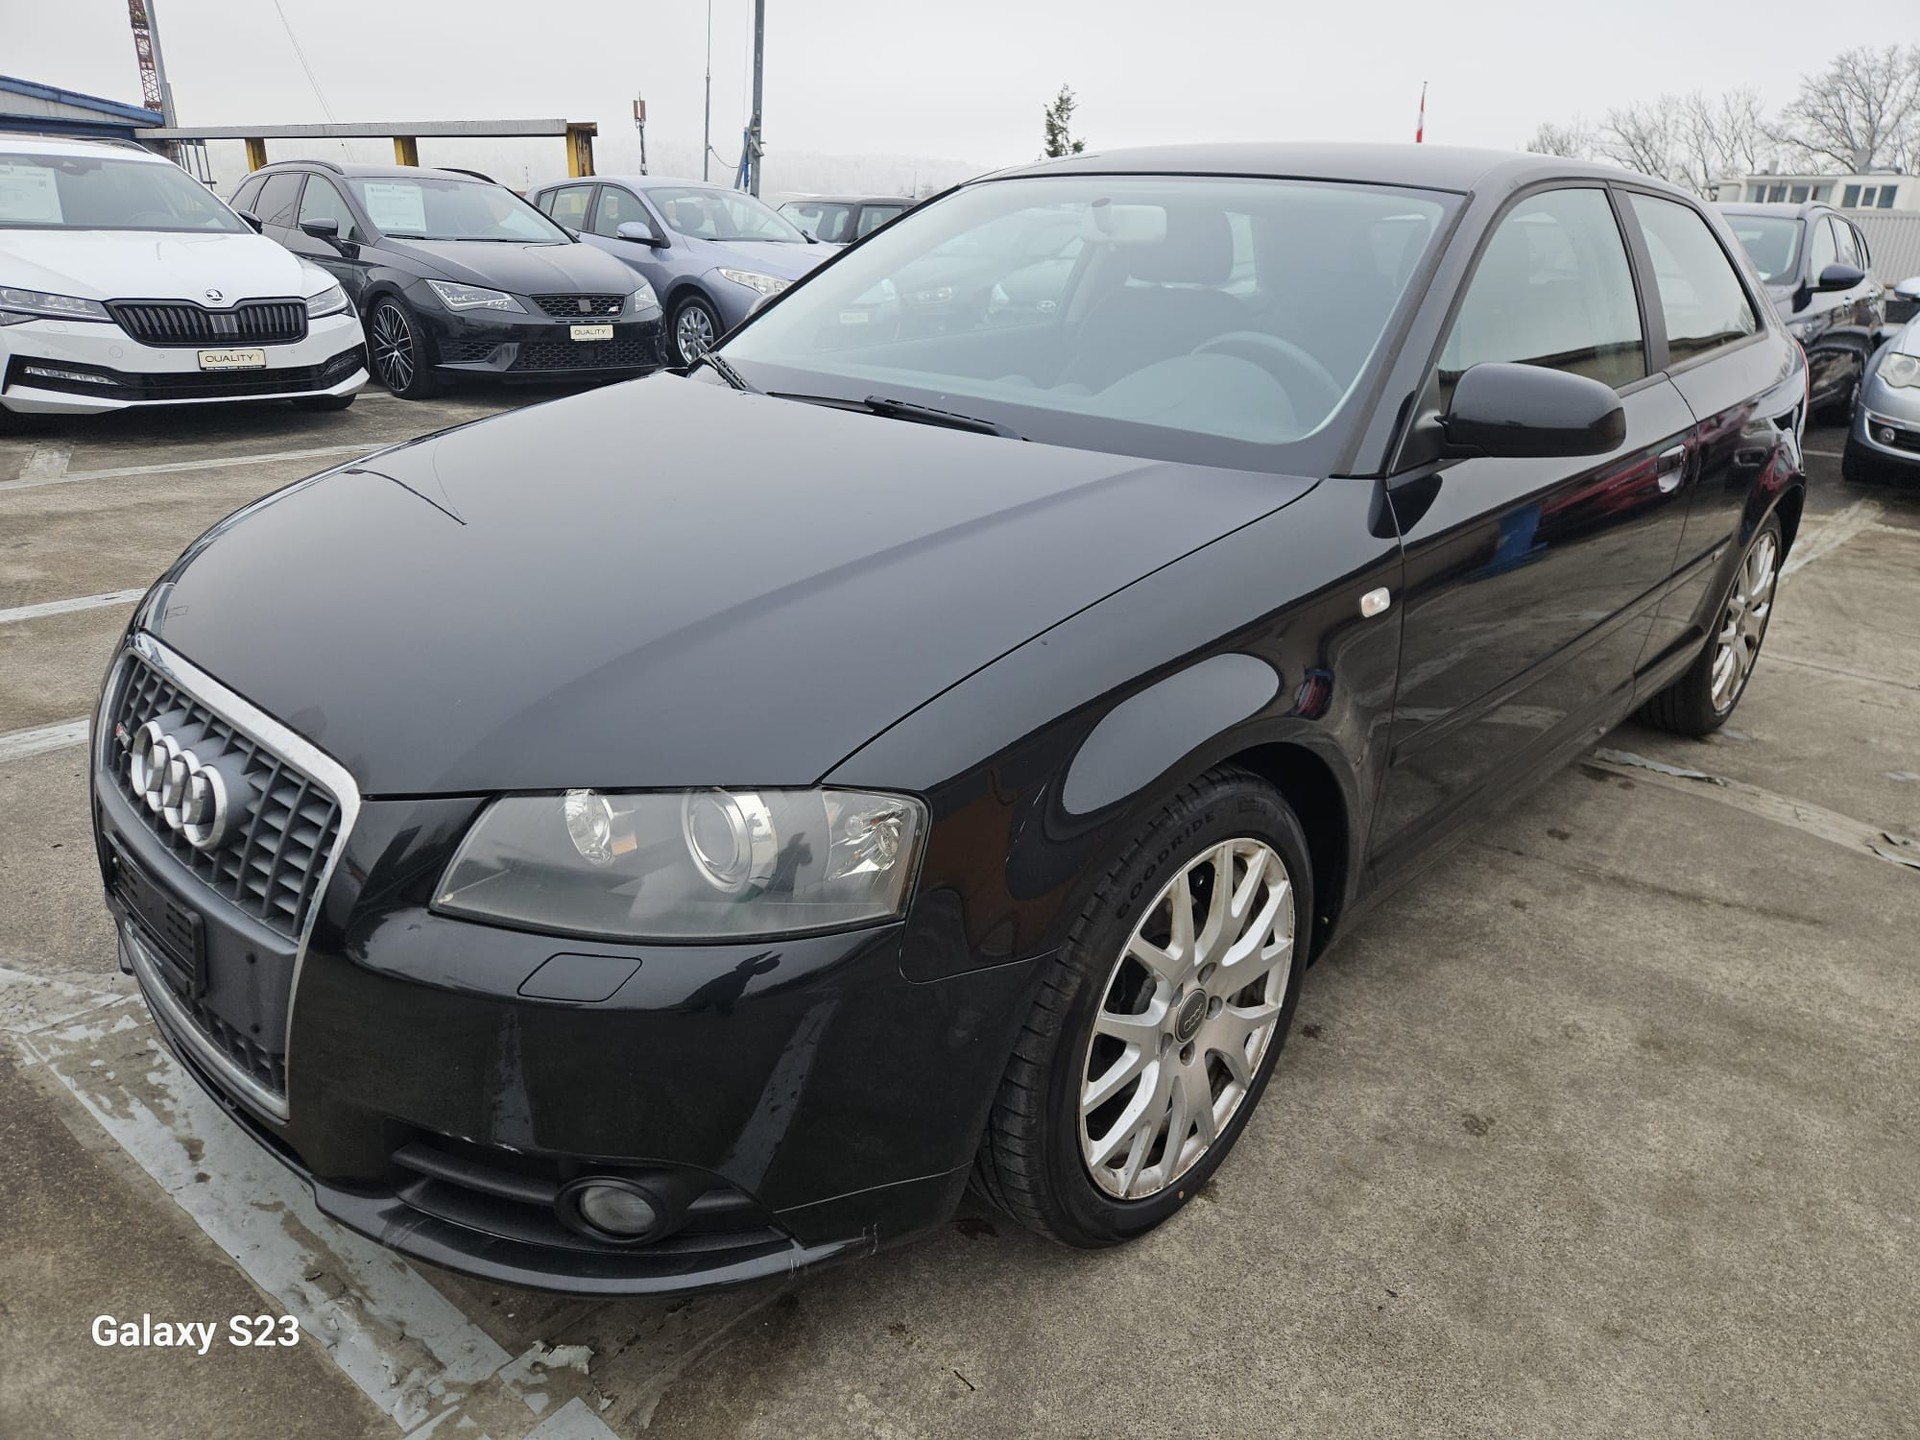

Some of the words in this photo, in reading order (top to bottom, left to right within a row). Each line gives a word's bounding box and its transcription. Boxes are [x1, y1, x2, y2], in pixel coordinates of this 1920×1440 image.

[574, 328, 606, 336] QUALITY
[204, 354, 254, 363] QUALITY
[1116, 810, 1215, 919] GOODRIDE
